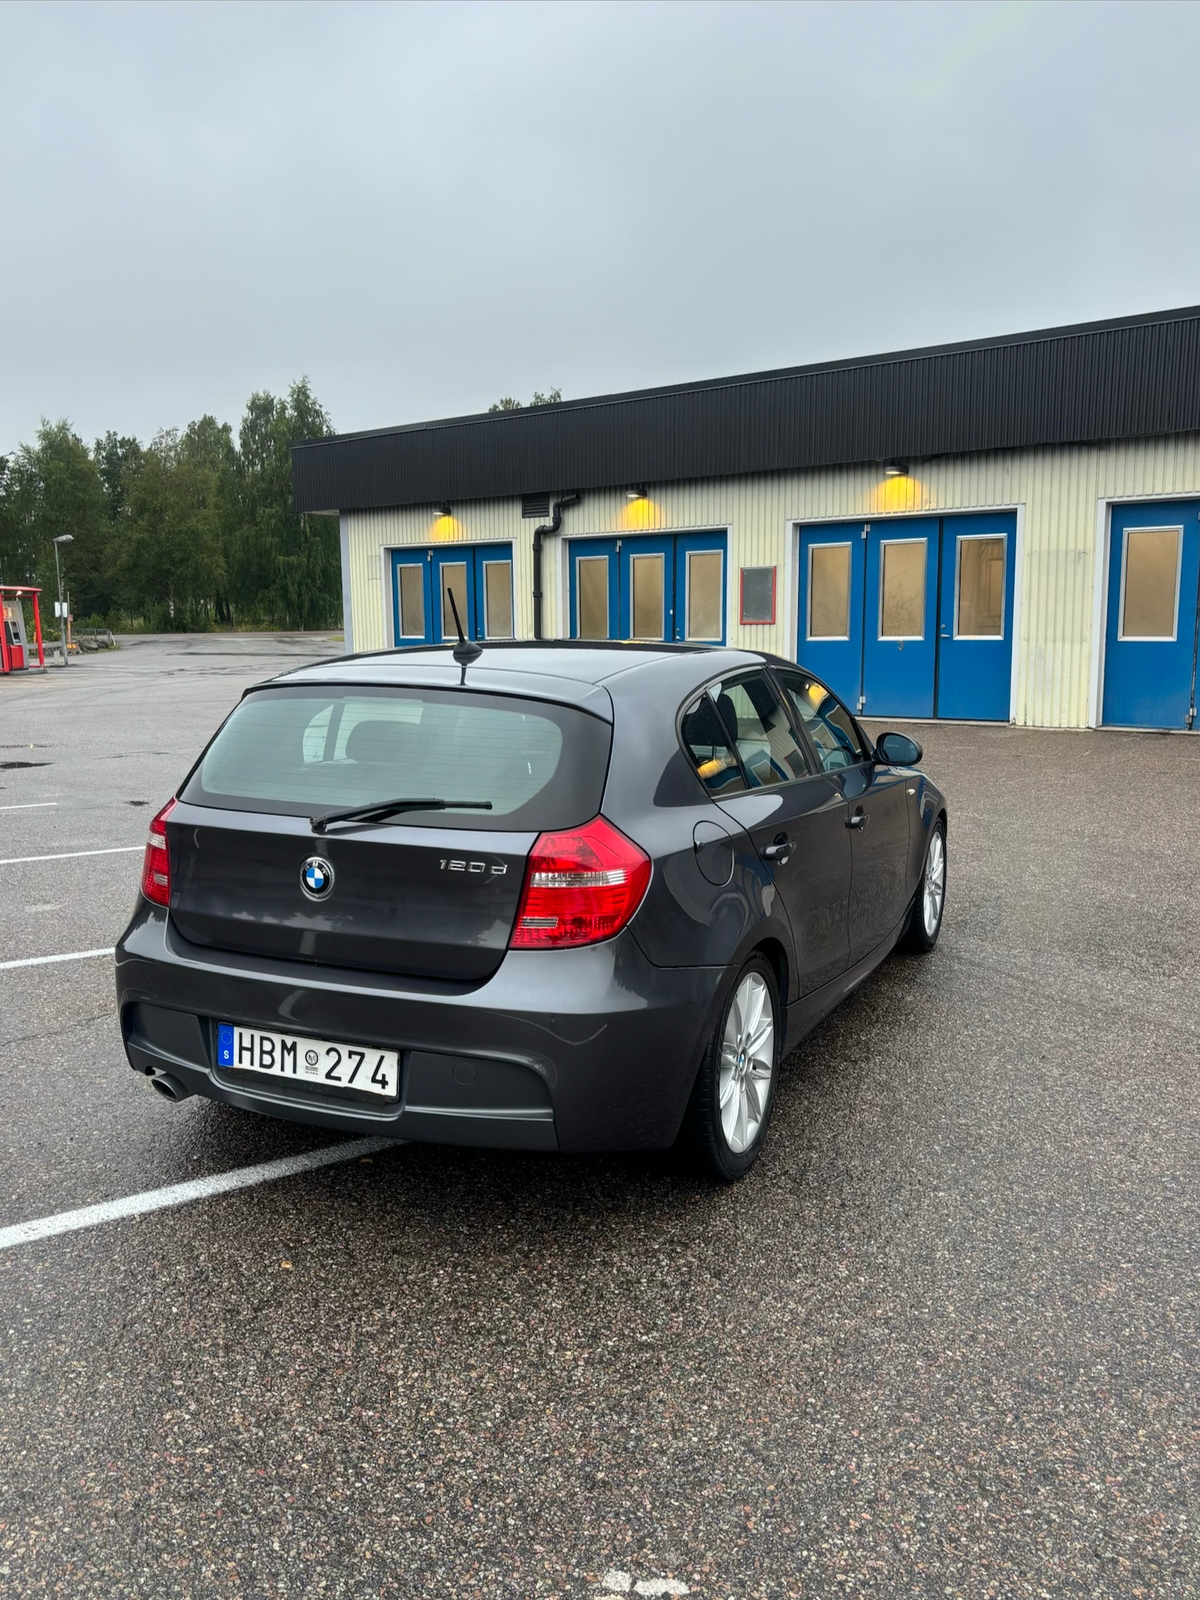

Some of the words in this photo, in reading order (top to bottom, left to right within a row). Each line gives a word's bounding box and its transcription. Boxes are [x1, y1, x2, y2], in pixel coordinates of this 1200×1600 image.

[223, 1049, 230, 1060] S
[238, 1032, 298, 1075] HBM
[324, 1047, 389, 1090] 274
